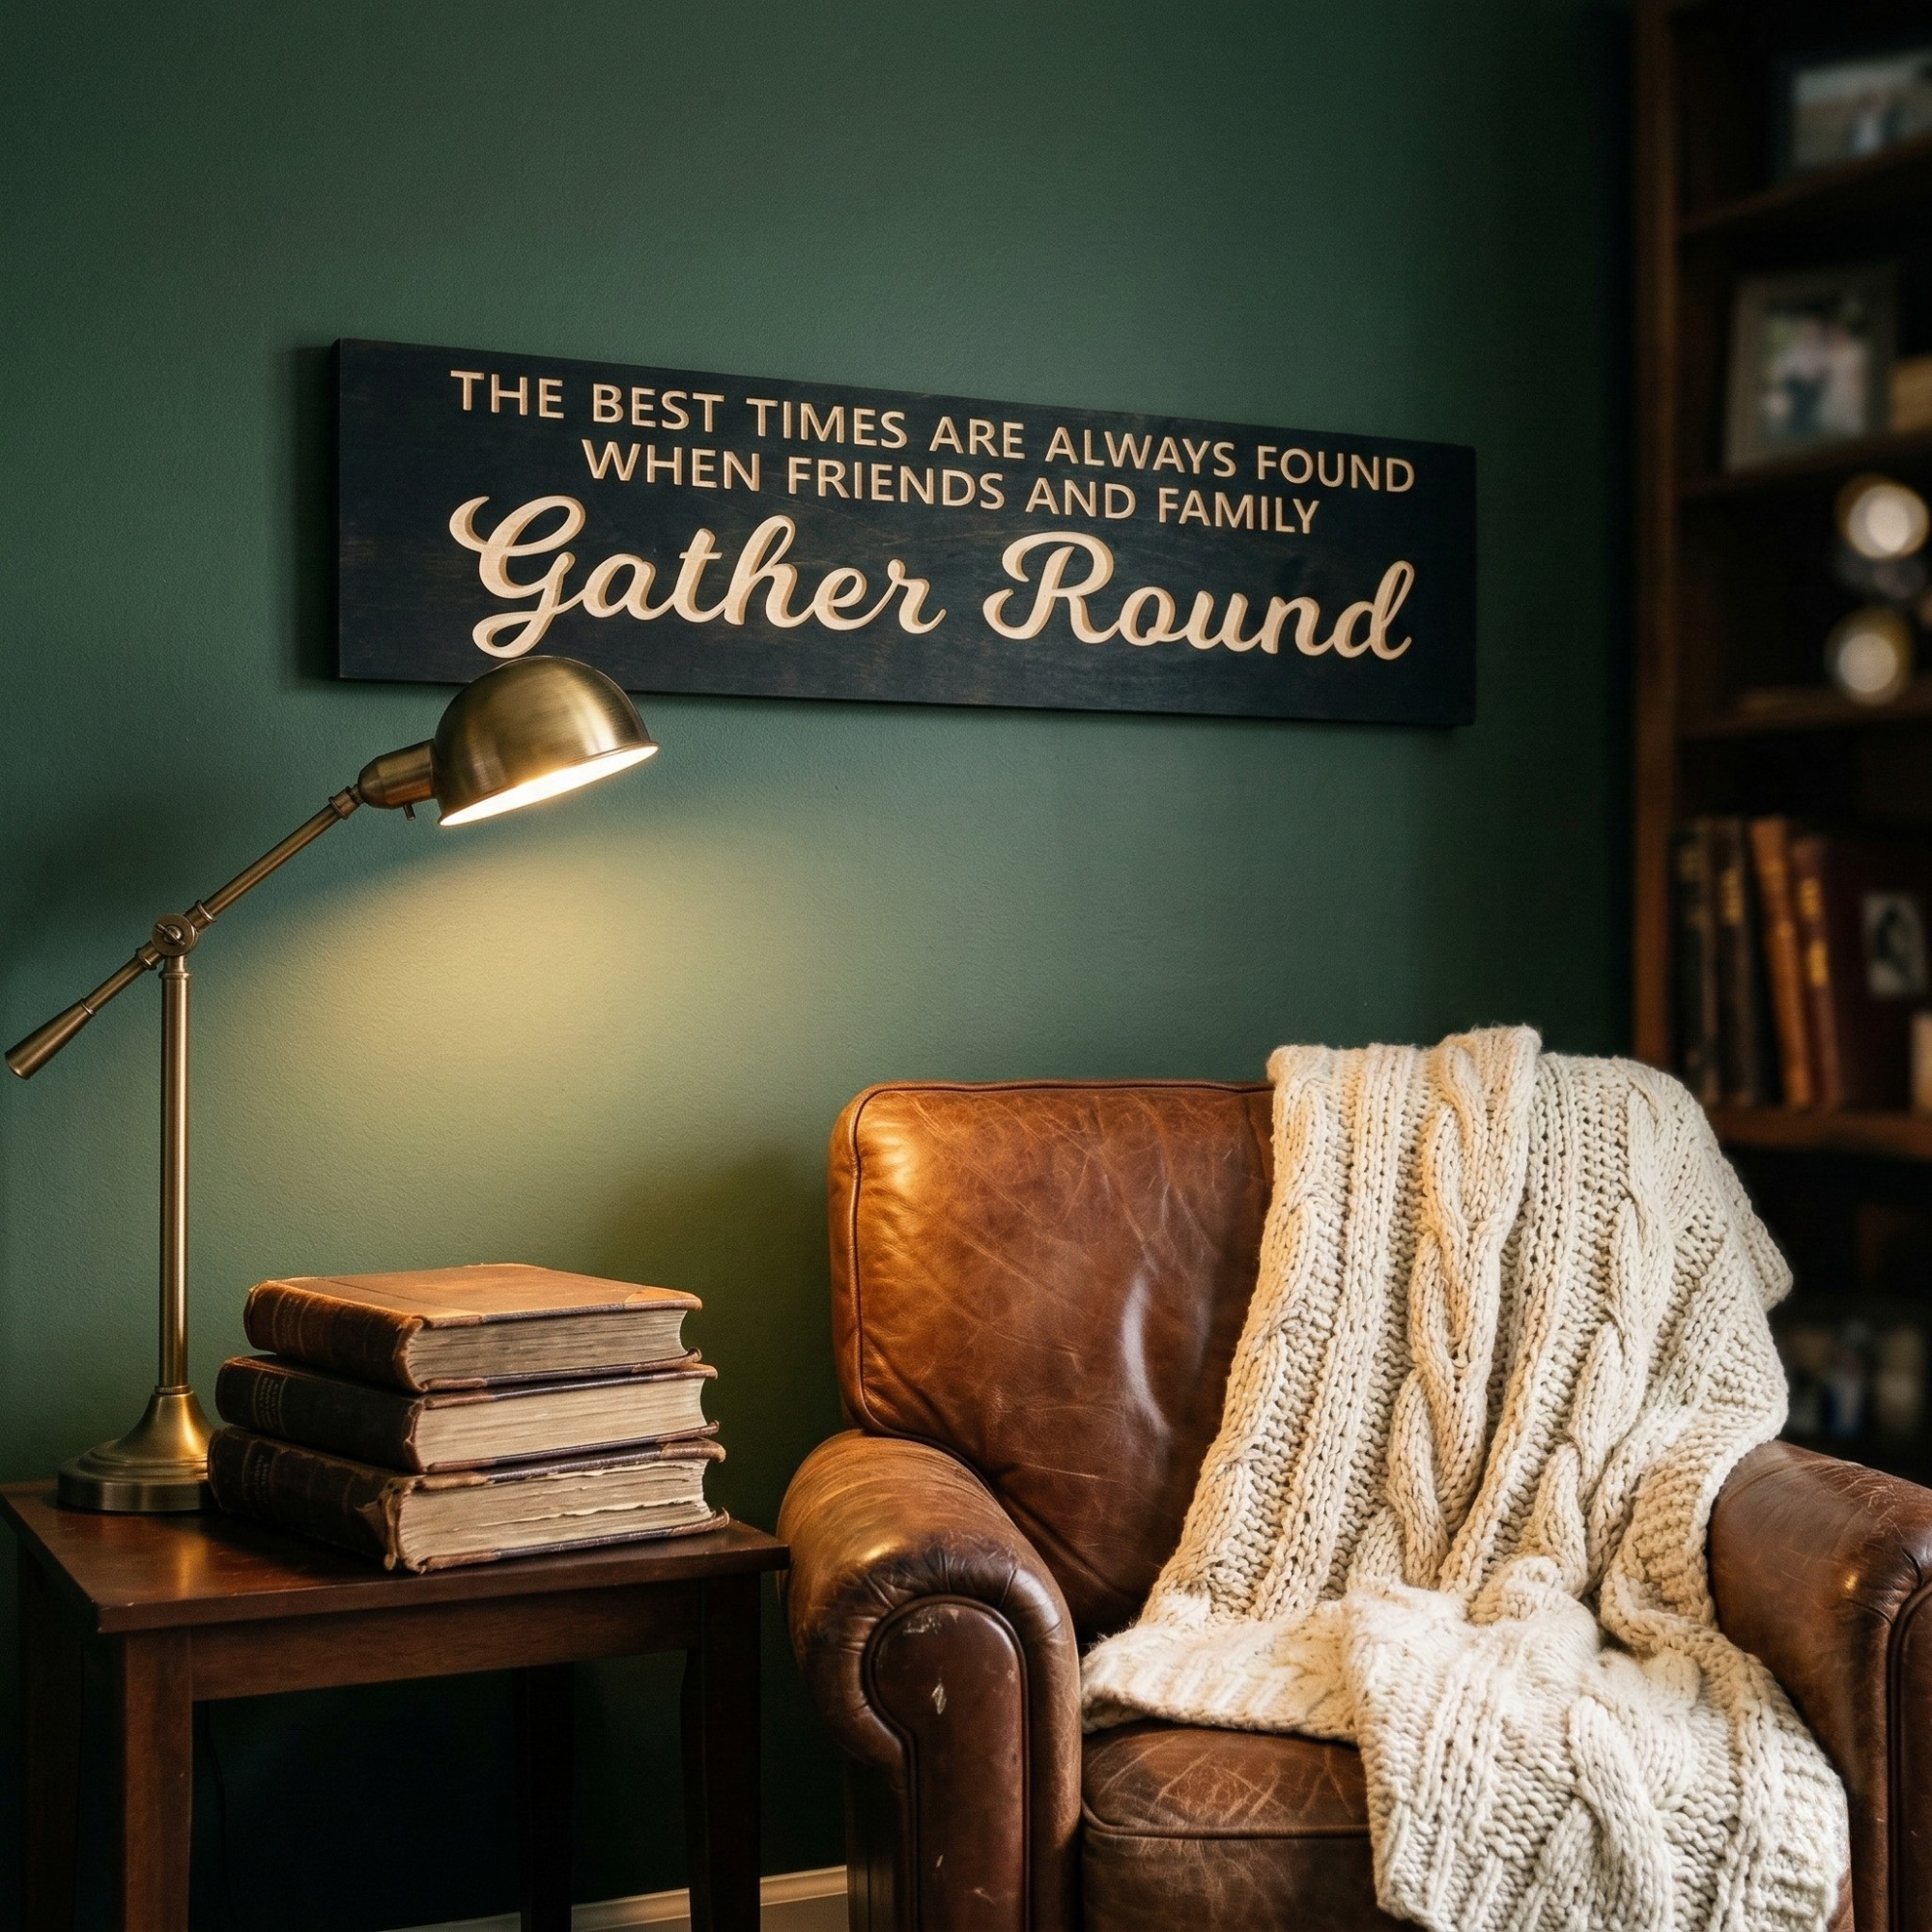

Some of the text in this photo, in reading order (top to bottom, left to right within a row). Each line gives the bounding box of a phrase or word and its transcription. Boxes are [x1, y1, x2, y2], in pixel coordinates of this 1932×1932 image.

[450, 370, 1413, 493] THE BEST TIMES ARE ALWAYS FOUND
[581, 439, 1320, 535] WHEN FRIENDS AND FAMILY
[449, 495, 1413, 661] Gather Round
